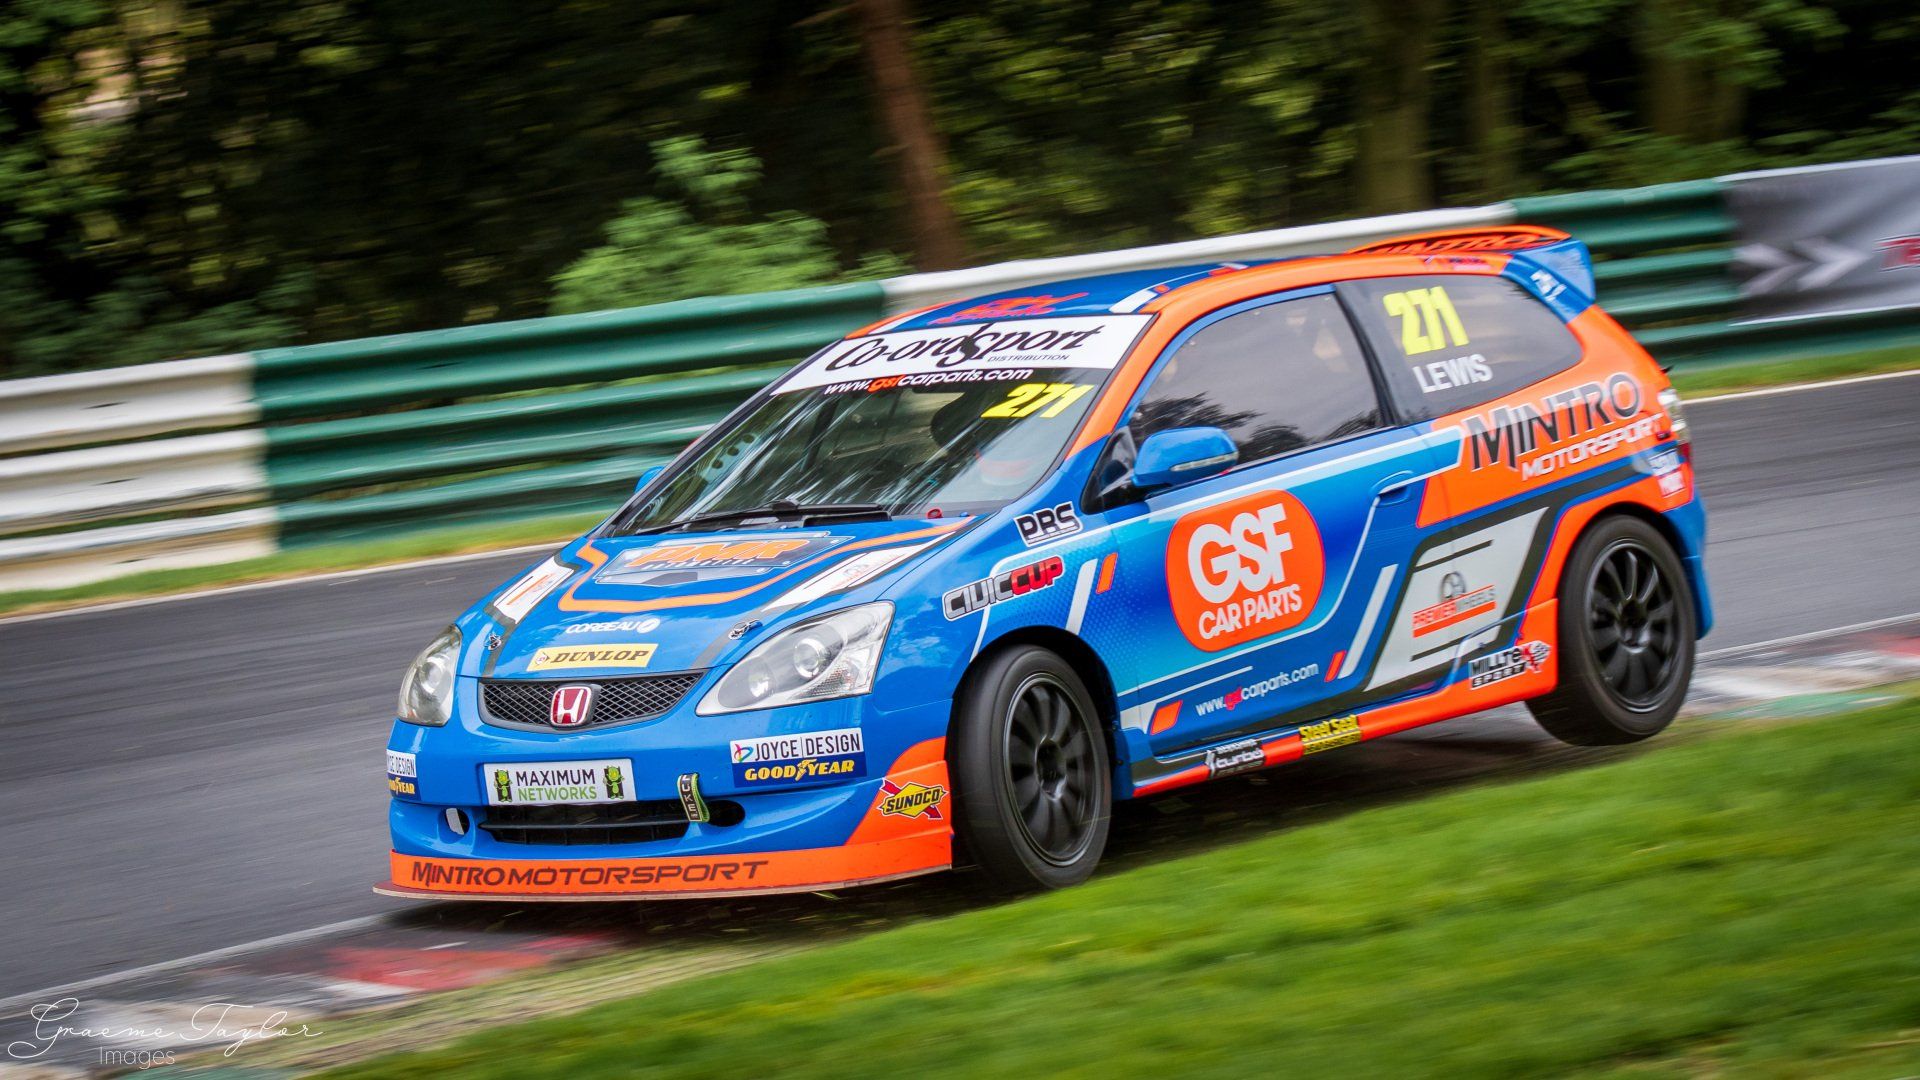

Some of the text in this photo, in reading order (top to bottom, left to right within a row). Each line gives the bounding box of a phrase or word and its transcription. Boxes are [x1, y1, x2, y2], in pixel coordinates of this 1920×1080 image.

[1383, 286, 1469, 355] 271
[987, 354, 1069, 363] DISTRIBUTION
[824, 368, 1034, 395] www.gsfcarparts.com
[1412, 353, 1493, 393] LEWIS
[980, 383, 1095, 418] 271
[1460, 372, 1643, 472] MINTRO
[1521, 412, 1663, 481] MOTORSPORT
[1187, 503, 1293, 603] GSF
[1198, 584, 1302, 640] CAR PARTS
[565, 621, 640, 634] CORBEAU
[551, 650, 649, 663] DUNLOP
[1472, 661, 1527, 688] SPORT
[1299, 720, 1331, 742] Steel
[1331, 714, 1359, 735] Seal
[755, 733, 861, 761] JOYCE DESIGN
[396, 756, 416, 777] DESIGN
[516, 768, 596, 786] MAXIMUM
[518, 786, 598, 801] NETWORKS
[886, 787, 941, 813] SUNOCO
[412, 860, 769, 888] MINTRO MOTORSPORT
